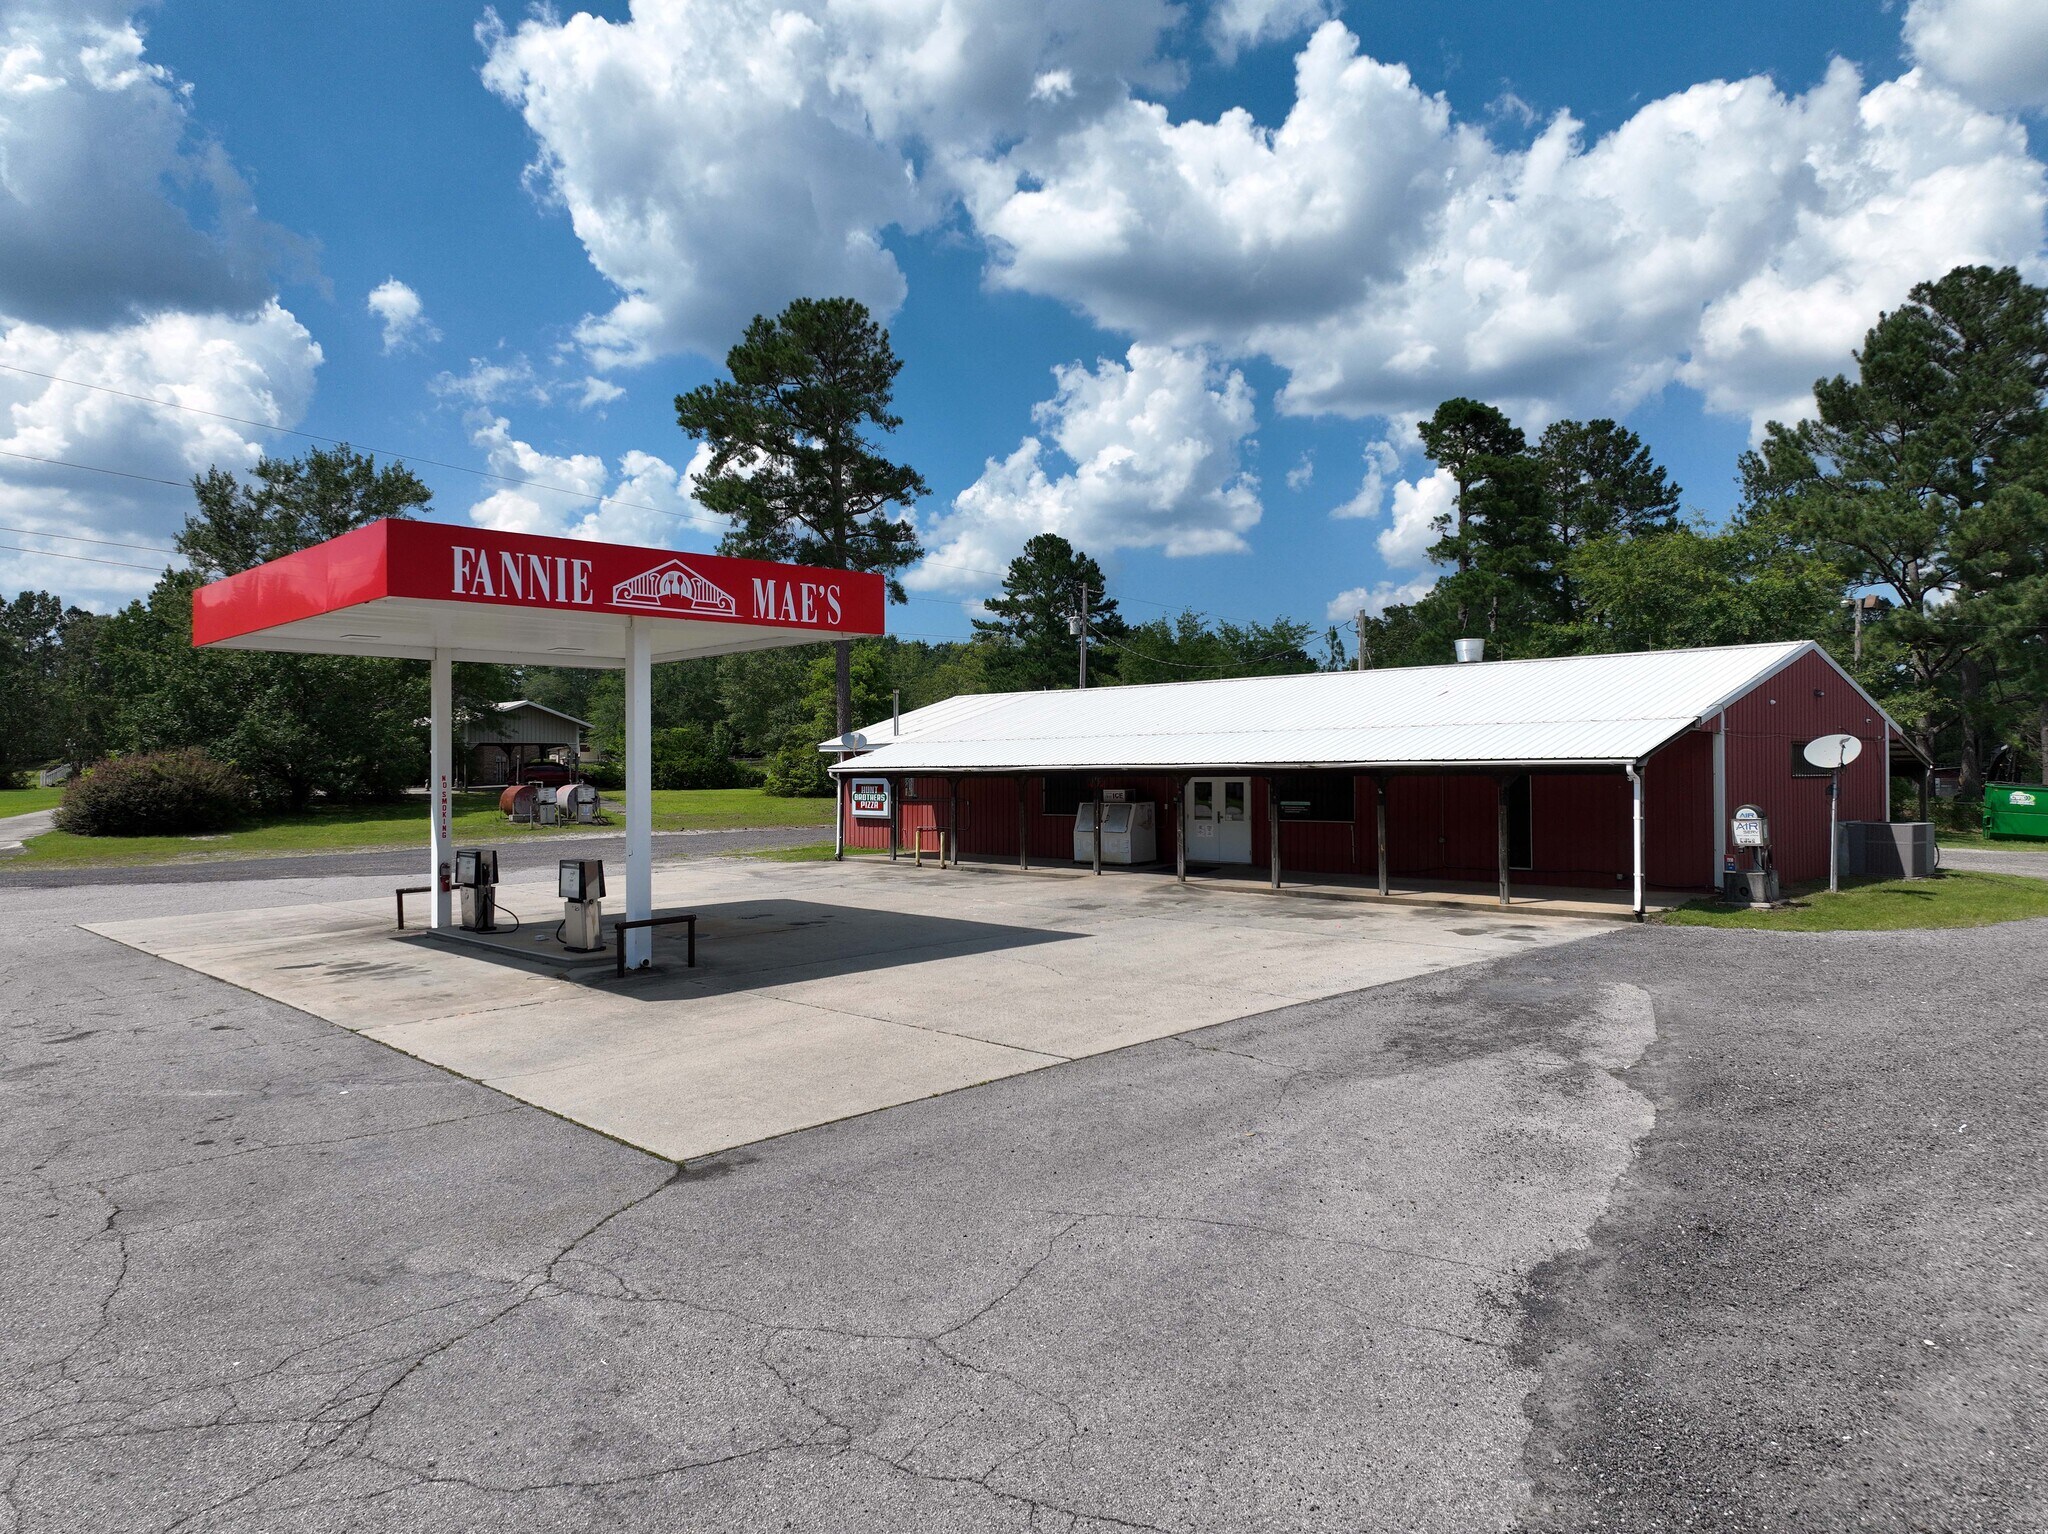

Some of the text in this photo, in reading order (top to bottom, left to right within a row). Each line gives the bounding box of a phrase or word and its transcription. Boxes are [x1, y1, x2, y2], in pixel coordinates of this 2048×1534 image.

[451, 544, 842, 626] FANNIE MAE'S
[441, 775, 448, 789] NO
[1112, 792, 1124, 800] ICE
[860, 801, 878, 809] PIZZA
[1736, 822, 1759, 831] AIR
